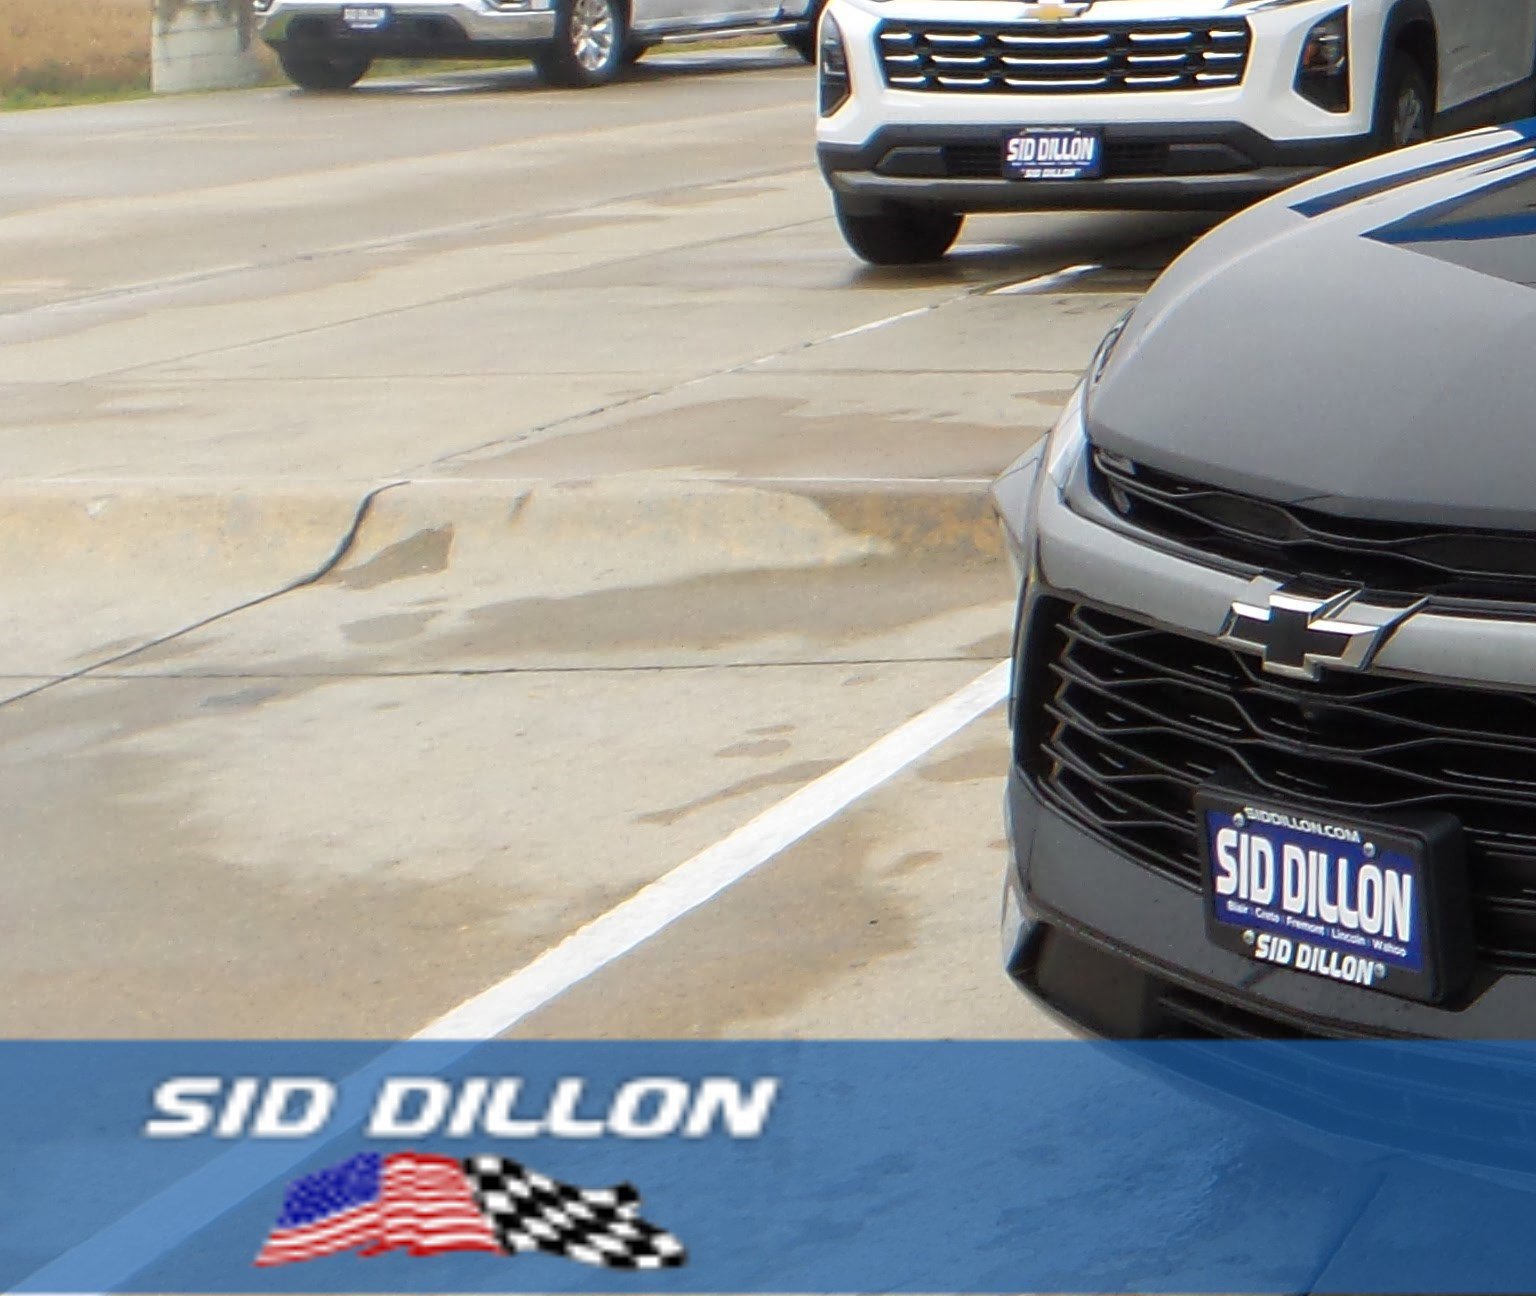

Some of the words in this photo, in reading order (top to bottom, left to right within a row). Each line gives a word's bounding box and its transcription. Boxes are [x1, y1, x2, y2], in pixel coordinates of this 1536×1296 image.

[1007, 137, 1035, 161] SID
[1037, 137, 1095, 161] DILLON
[1243, 807, 1361, 843] SIDDILLON.COM
[1216, 827, 1275, 905] SID
[1282, 843, 1412, 943] DILLON
[1254, 933, 1292, 965] SID
[1295, 943, 1374, 986] DILLON
